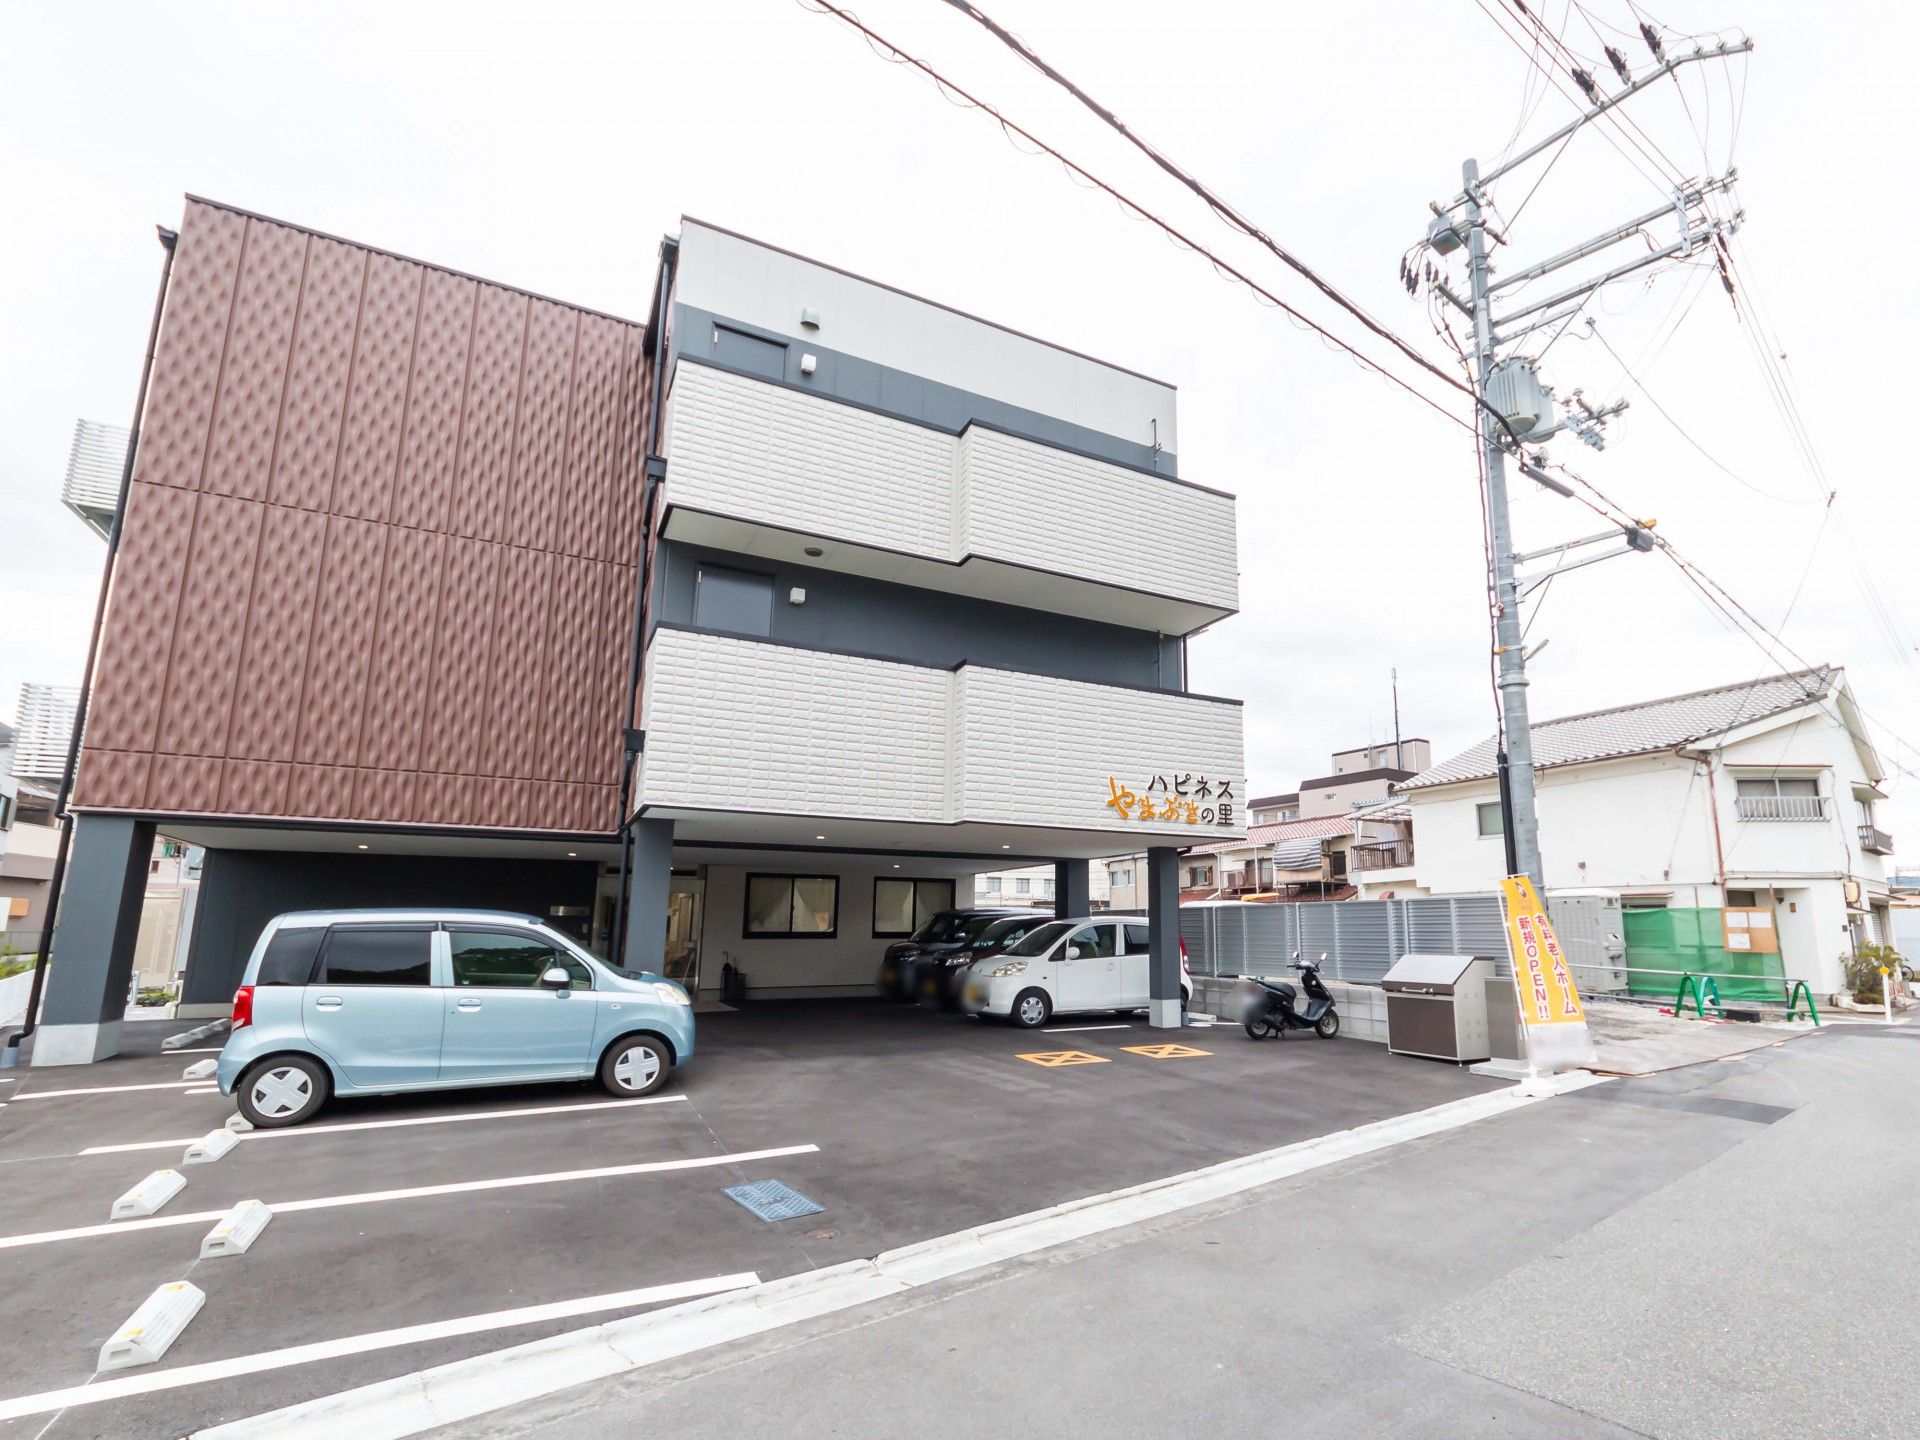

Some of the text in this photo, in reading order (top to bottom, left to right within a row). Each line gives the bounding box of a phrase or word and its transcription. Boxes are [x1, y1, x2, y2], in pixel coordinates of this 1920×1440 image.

[1147, 773, 1234, 800] ハピネス
[1535, 914, 1578, 1015] 有料老人ホーム
